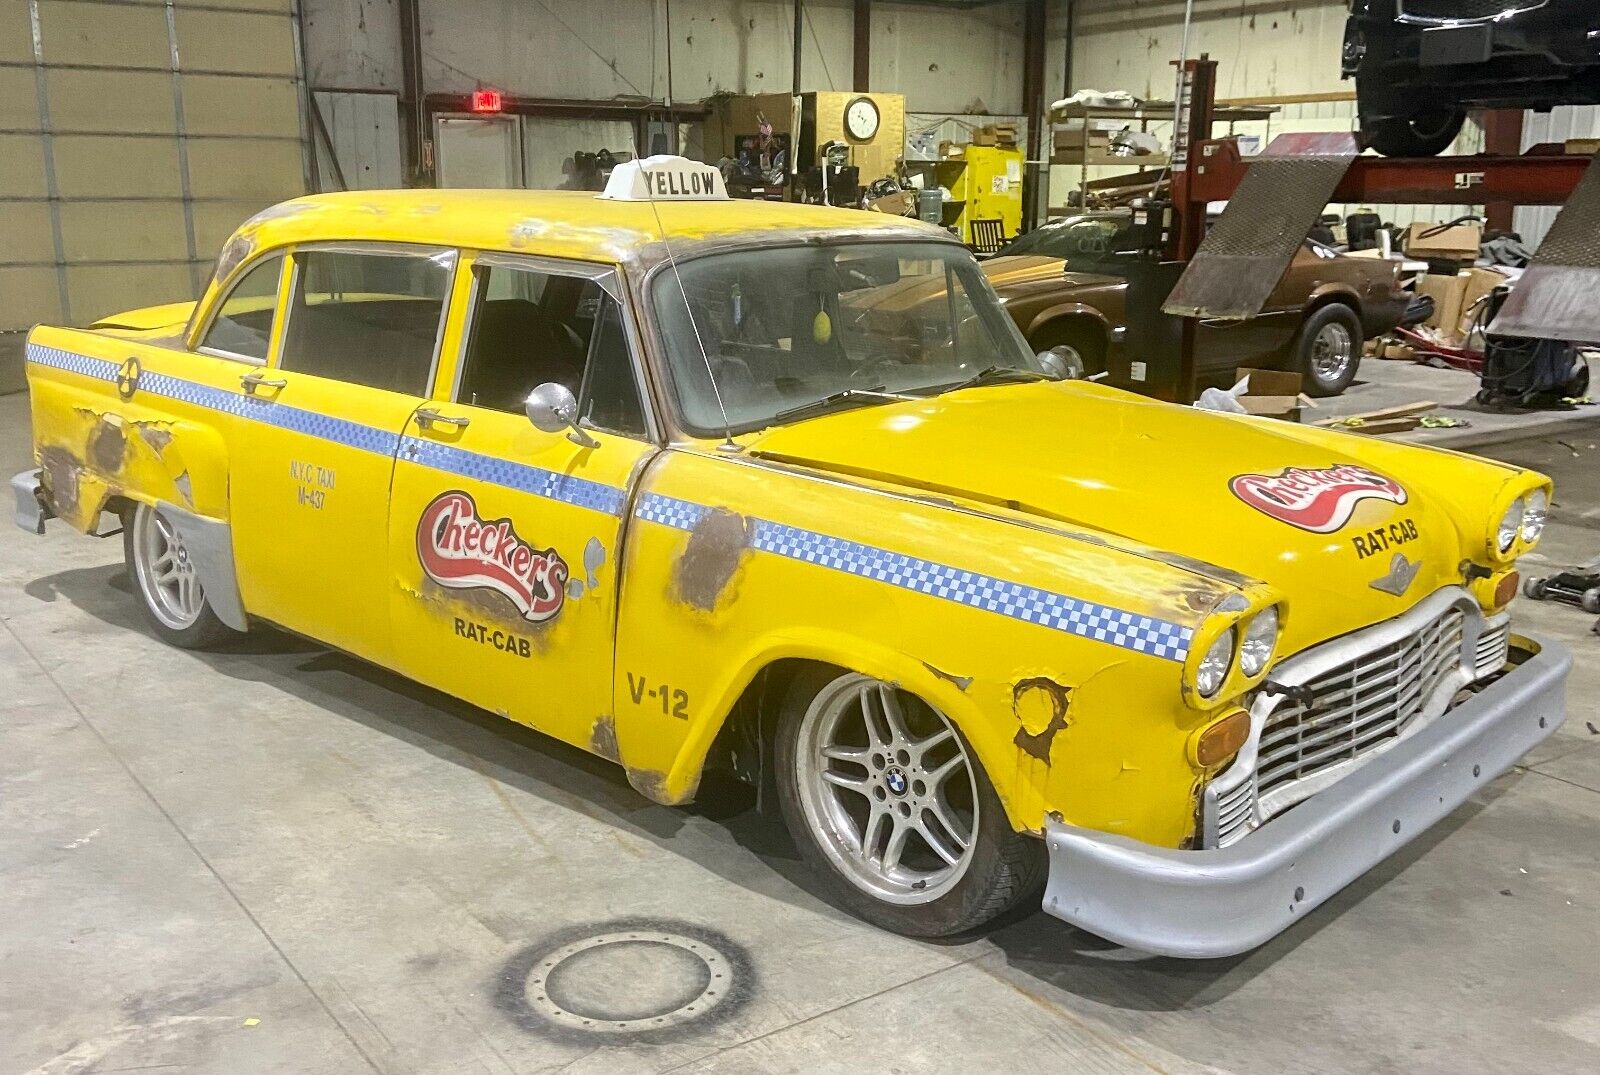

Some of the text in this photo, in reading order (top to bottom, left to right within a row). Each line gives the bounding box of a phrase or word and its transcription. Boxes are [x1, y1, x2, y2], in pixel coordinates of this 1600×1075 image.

[643, 171, 714, 195] YELLOW
[297, 485, 325, 511] M-437
[316, 466, 335, 490] TAXI
[417, 492, 568, 621] Checker's
[1351, 518, 1419, 560] RAT-CAB
[454, 616, 532, 659] RAT-CAB
[626, 671, 689, 721] V-12
